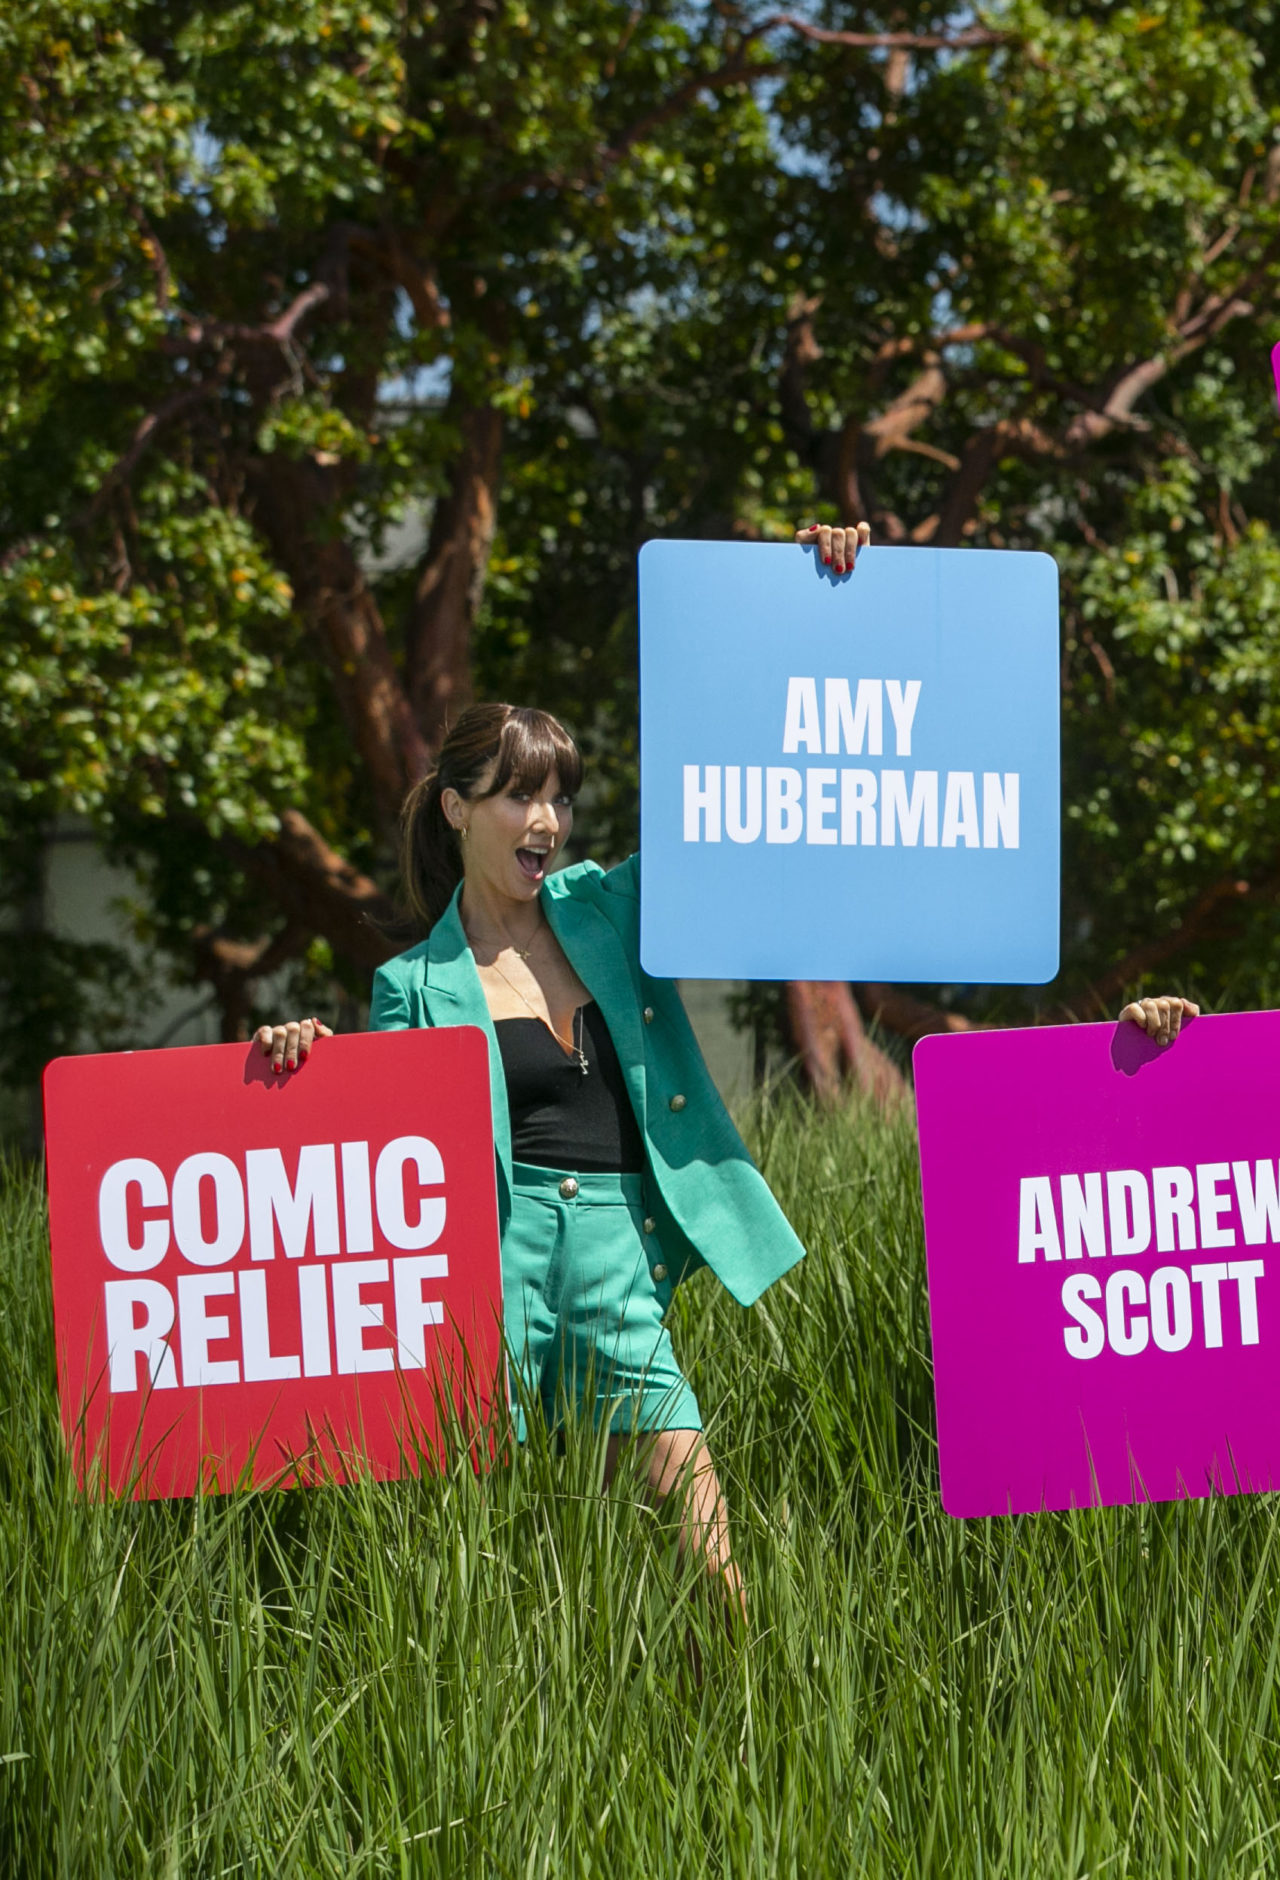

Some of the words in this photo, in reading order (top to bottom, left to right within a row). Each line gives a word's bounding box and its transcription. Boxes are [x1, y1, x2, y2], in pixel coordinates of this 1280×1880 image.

[782, 676, 922, 757] AMY
[683, 764, 1020, 849] HUBERMAN
[99, 1136, 447, 1272] COMIC
[104, 1254, 449, 1393] RELIEF
[1061, 1260, 1264, 1360] SCOTT
